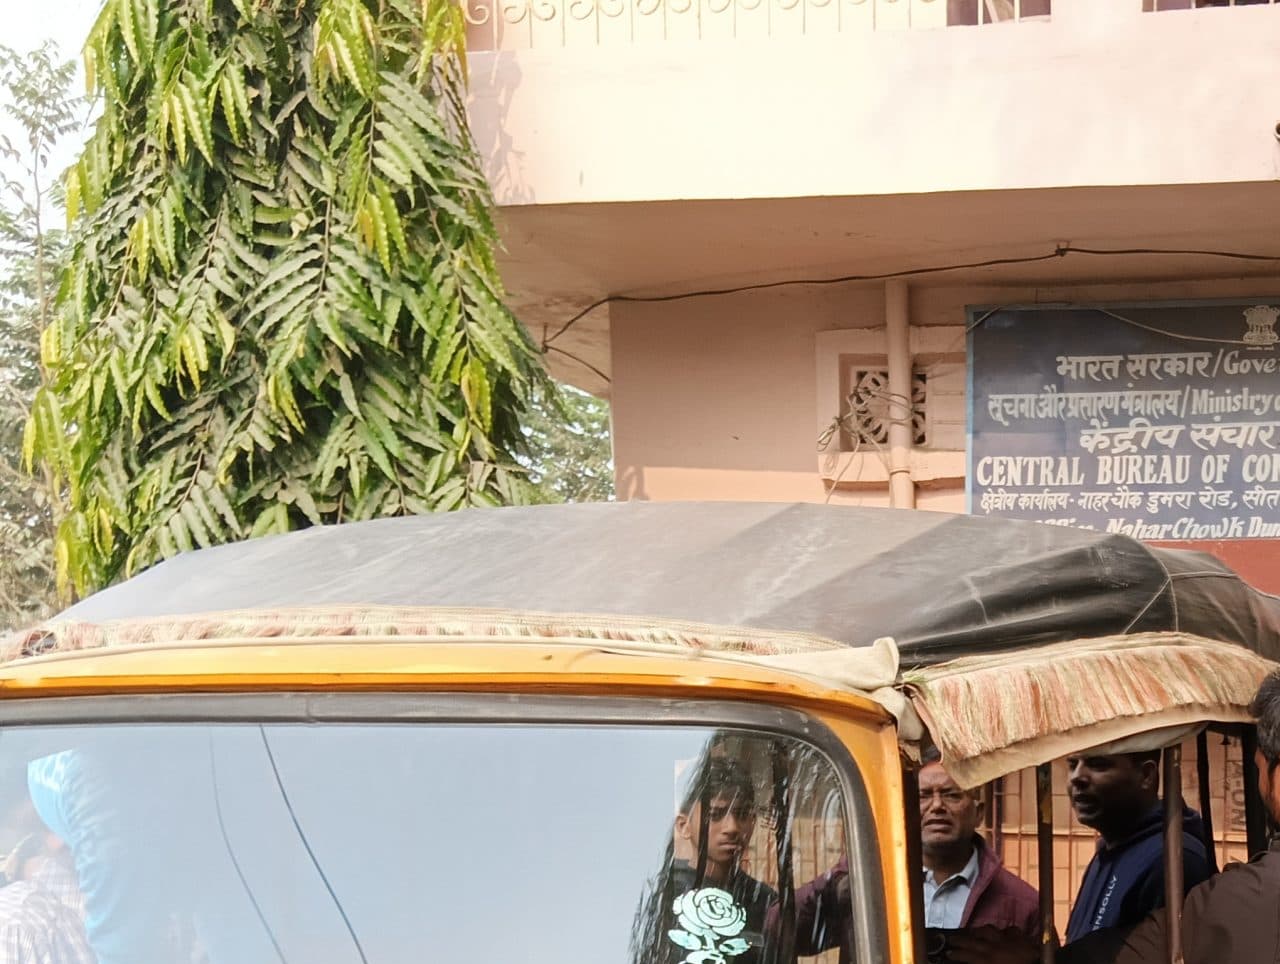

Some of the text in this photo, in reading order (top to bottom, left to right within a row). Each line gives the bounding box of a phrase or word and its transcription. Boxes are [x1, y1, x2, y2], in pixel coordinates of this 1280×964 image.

[1056, 354, 1123, 382] भारत
[1080, 417, 1186, 454] केंद्रीय
[1190, 415, 1280, 450] संचार
[977, 455, 1085, 487] CENTRAL
[1096, 454, 1191, 486] BUREAU
[1200, 453, 1231, 485] OF
